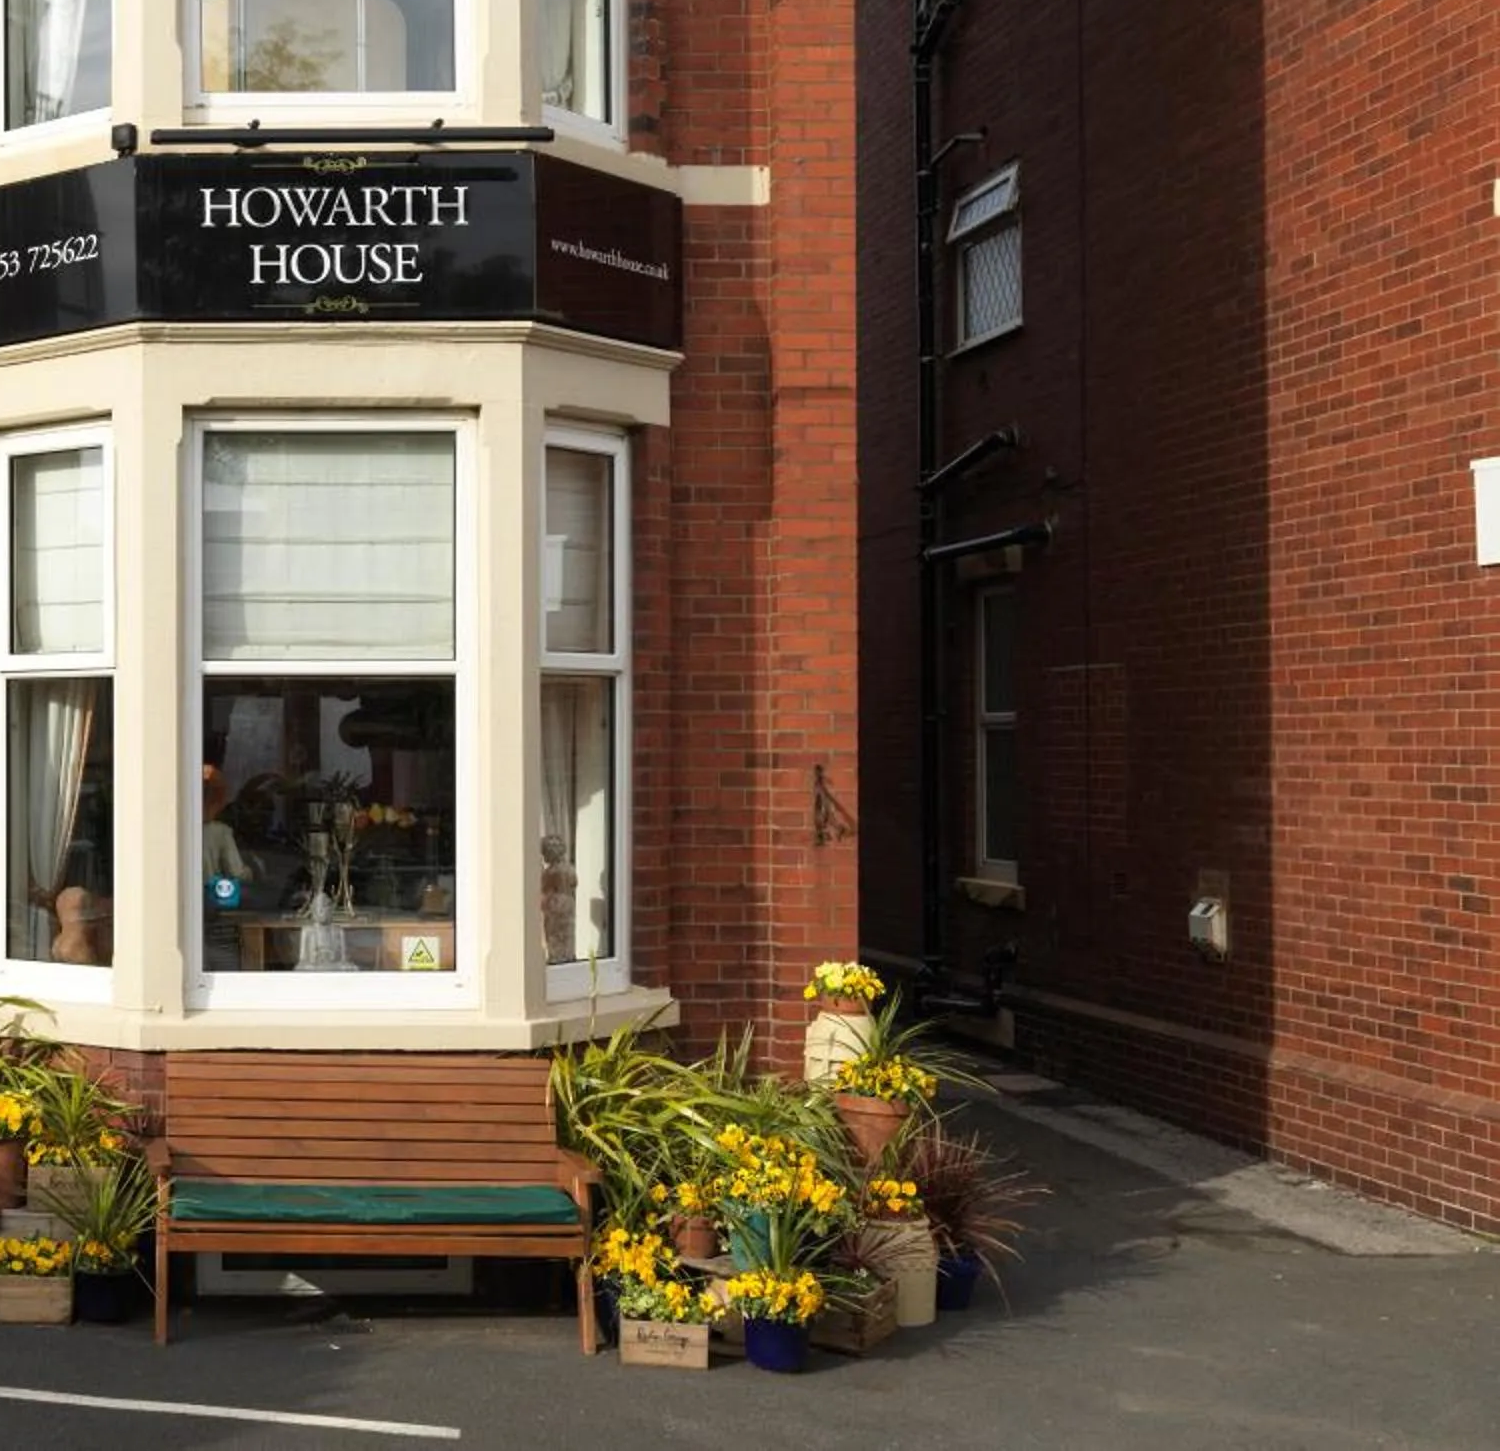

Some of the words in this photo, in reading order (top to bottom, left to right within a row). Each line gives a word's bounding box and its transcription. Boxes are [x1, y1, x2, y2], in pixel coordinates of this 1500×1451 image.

[199, 186, 470, 228] HOWARTH
[27, 233, 99, 274] 725622
[249, 243, 424, 284] HOUSE
